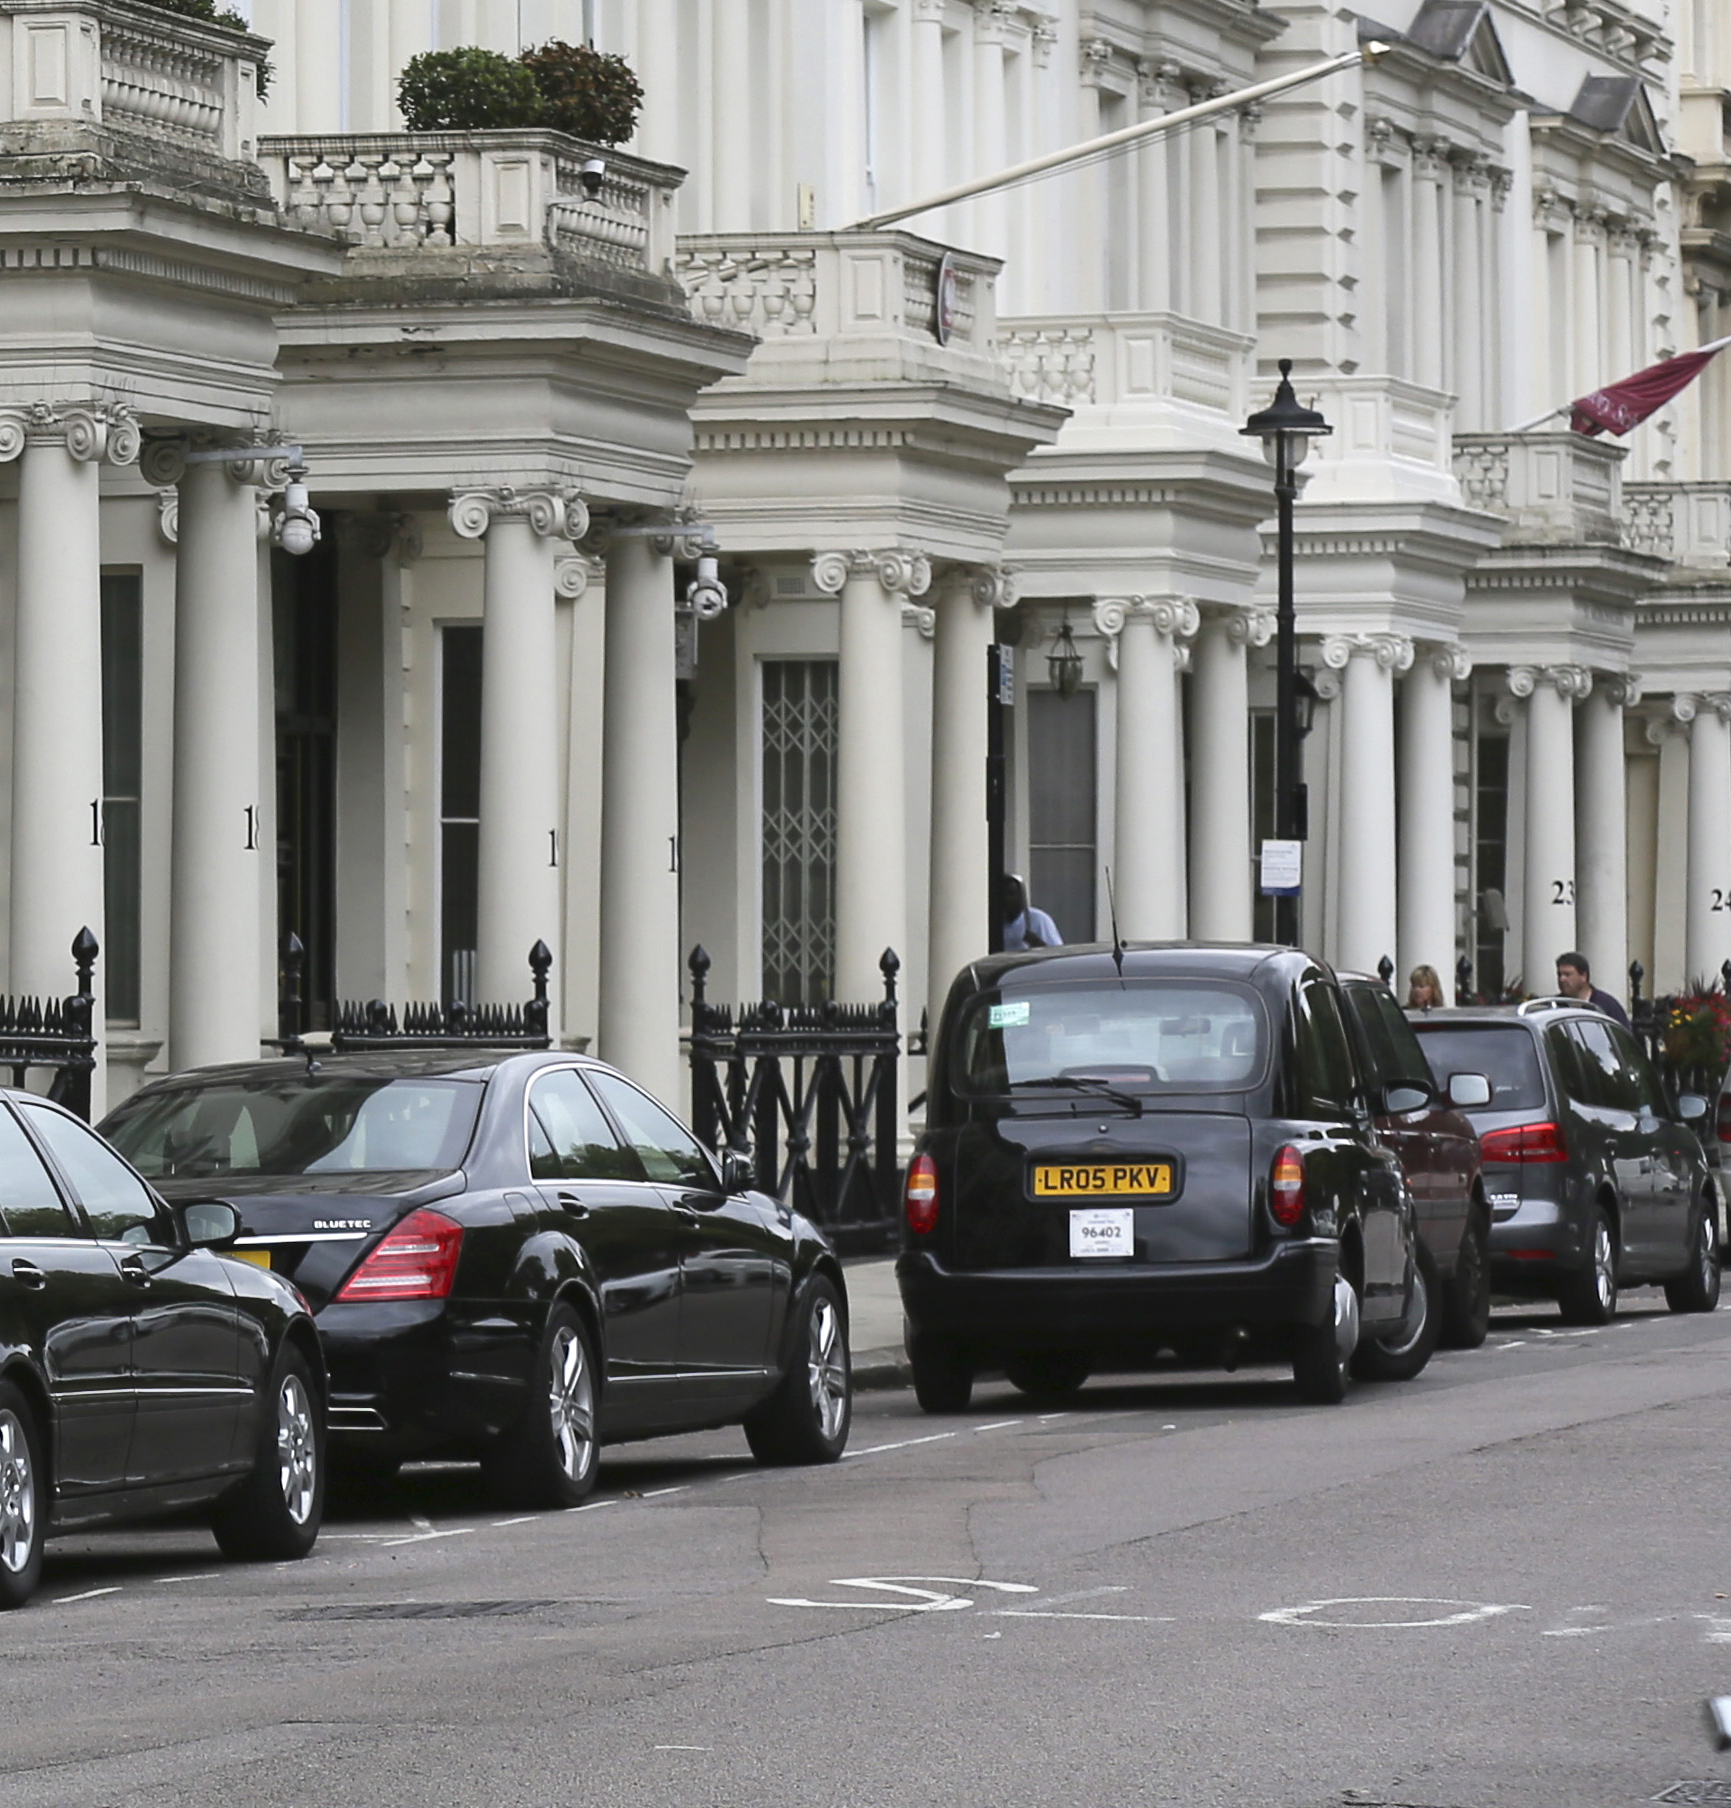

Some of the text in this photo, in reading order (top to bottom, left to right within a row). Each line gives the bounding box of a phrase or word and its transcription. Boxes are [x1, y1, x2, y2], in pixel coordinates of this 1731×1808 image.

[1044, 1167, 1160, 1190] LR05 PKV
[313, 1219, 372, 1229] BLUETEC
[1081, 1226, 1122, 1239] 96402
